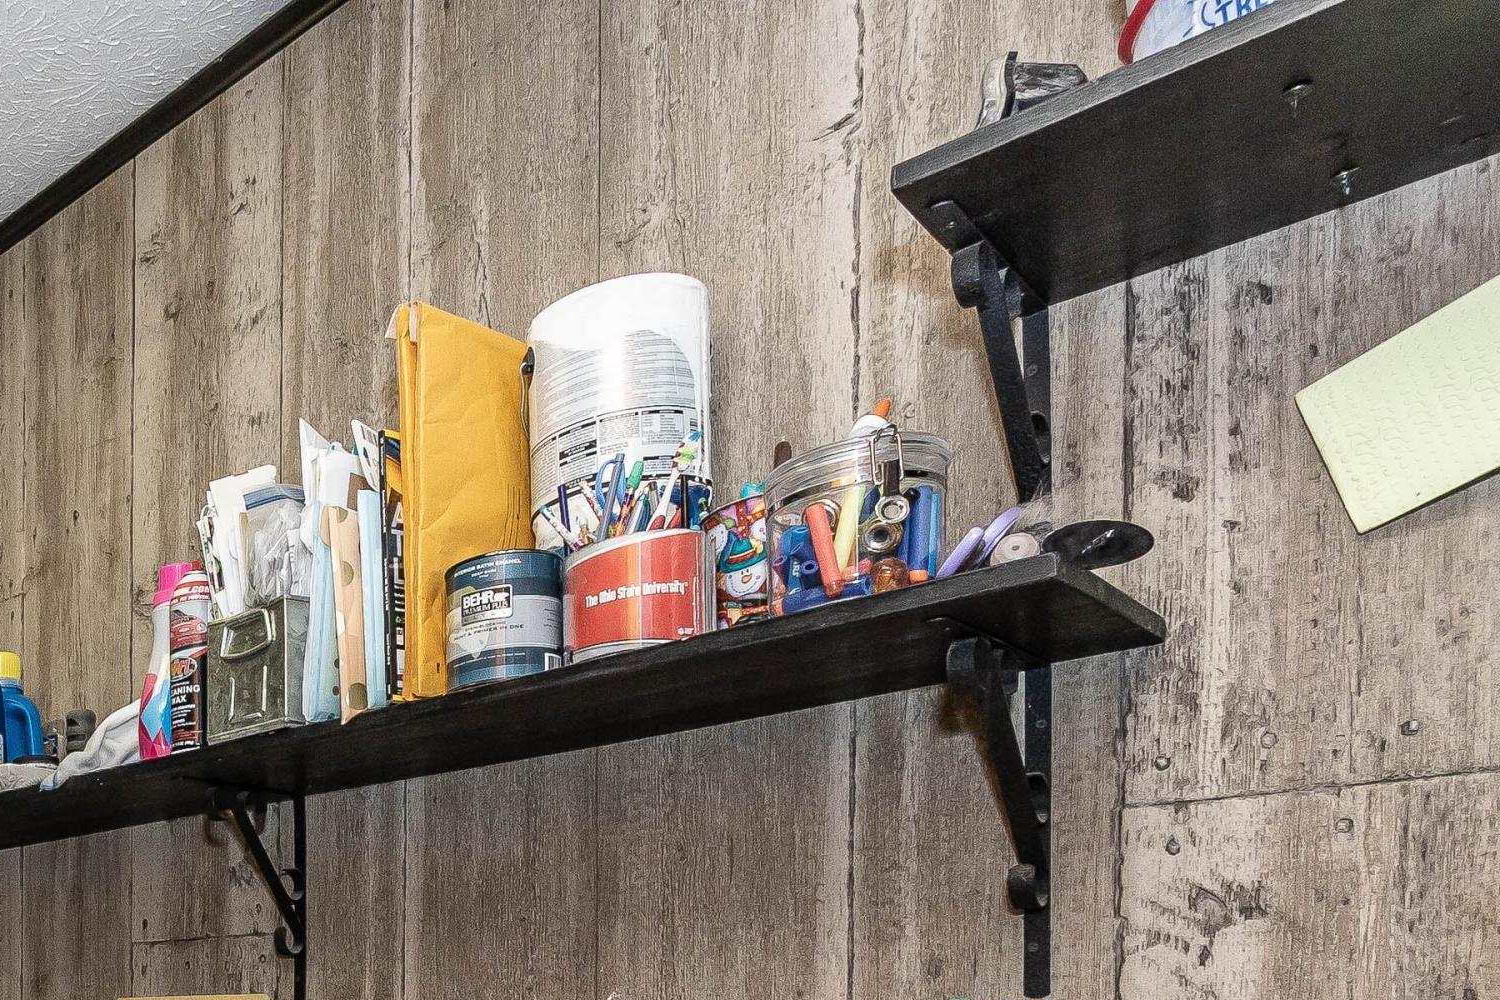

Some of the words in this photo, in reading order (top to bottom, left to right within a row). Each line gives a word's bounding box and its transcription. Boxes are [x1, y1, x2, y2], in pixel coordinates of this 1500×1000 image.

[476, 562, 495, 570] SATIN
[462, 589, 494, 609] BEHR
[585, 594, 598, 609] The
[598, 588, 616, 604] Ohio
[616, 584, 641, 599] State
[642, 579, 684, 595] University
[462, 602, 490, 616] PREMIUM
[171, 685, 201, 698] EANING
